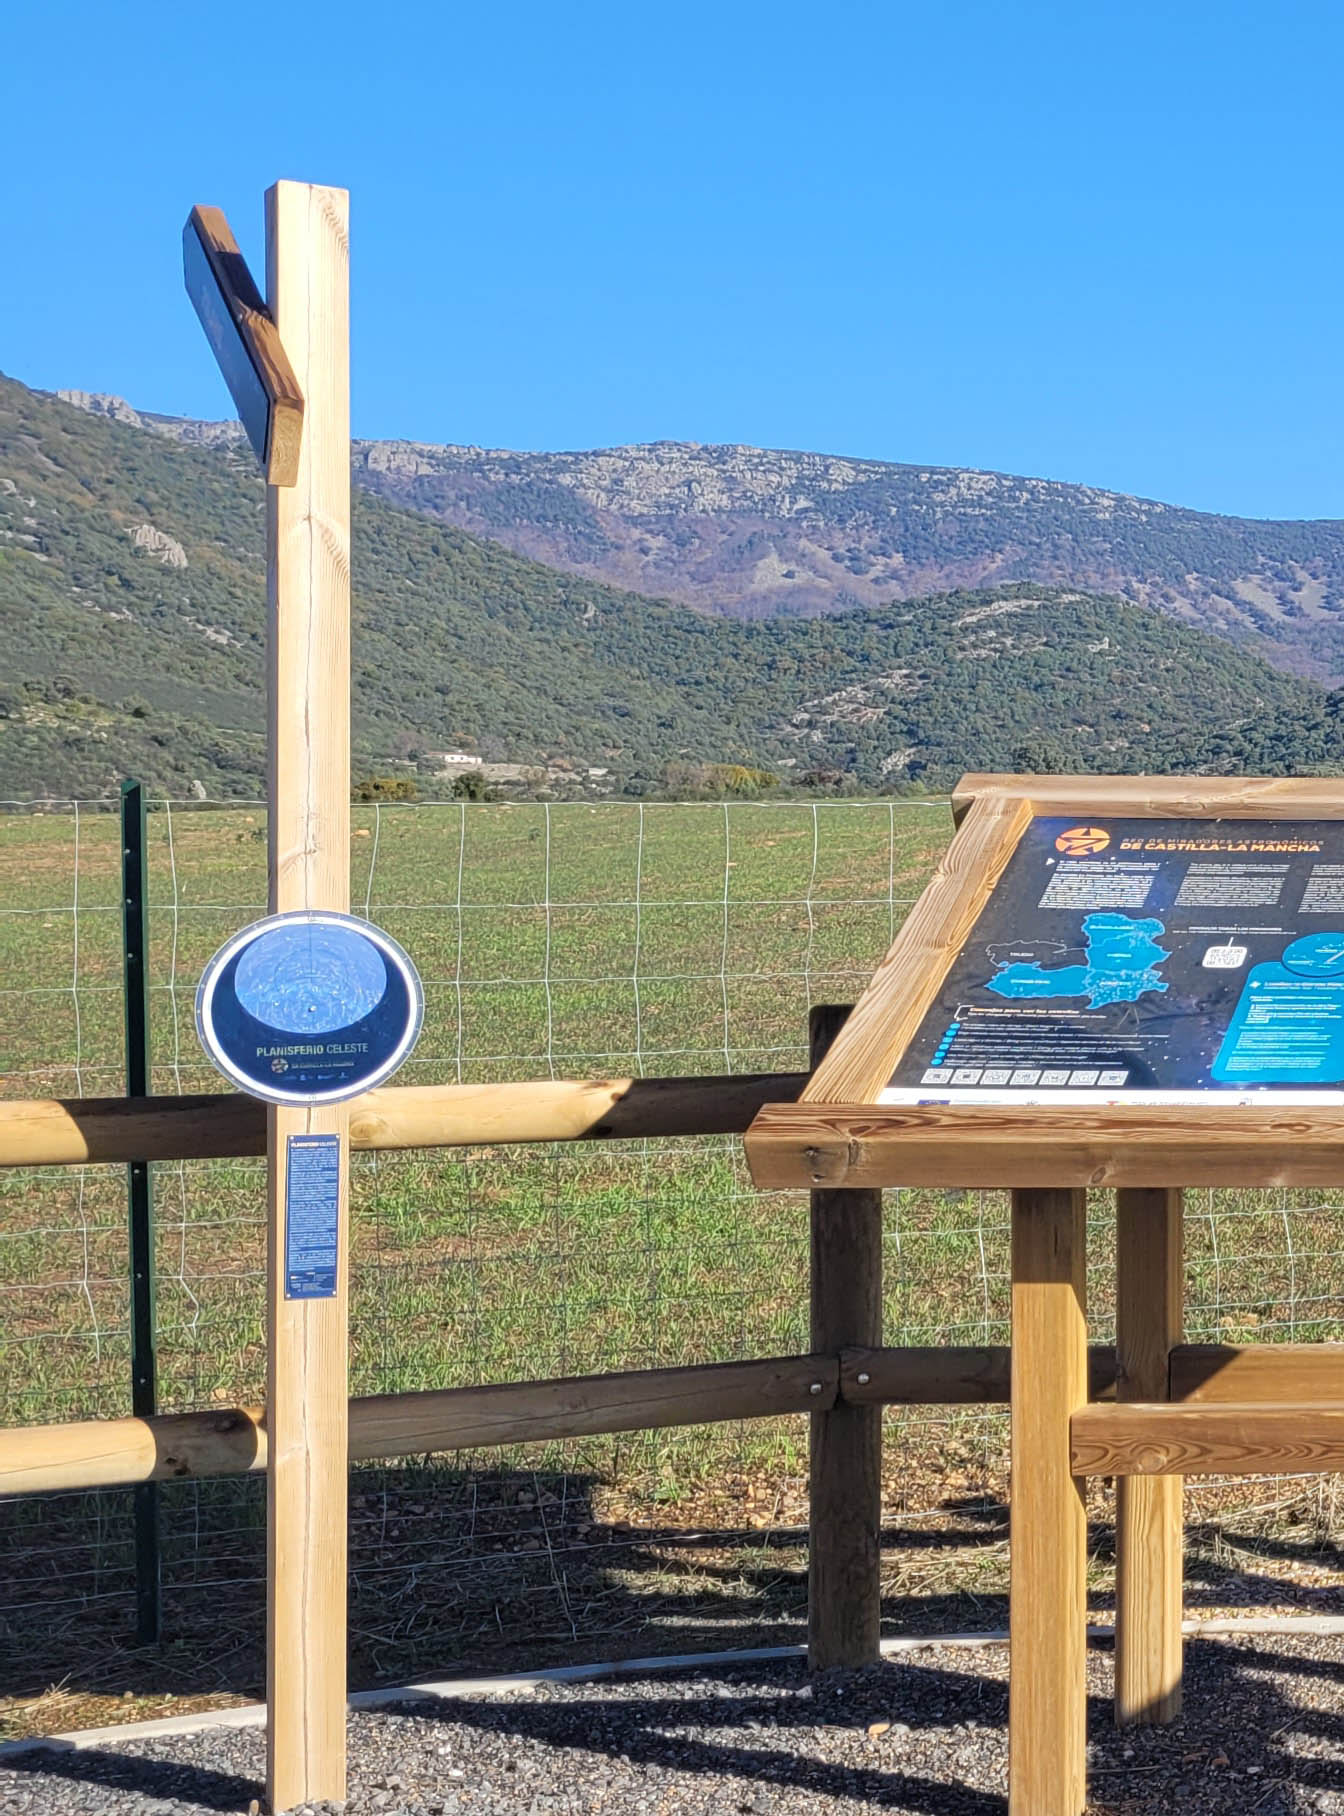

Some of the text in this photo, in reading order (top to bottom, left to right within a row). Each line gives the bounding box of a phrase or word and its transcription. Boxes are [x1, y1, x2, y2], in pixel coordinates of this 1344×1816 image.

[1144, 843, 1248, 852] CASTILLA-LA
[1250, 844, 1321, 852] MANCHA
[256, 1043, 369, 1057] PLANISFERIO CELESTE
